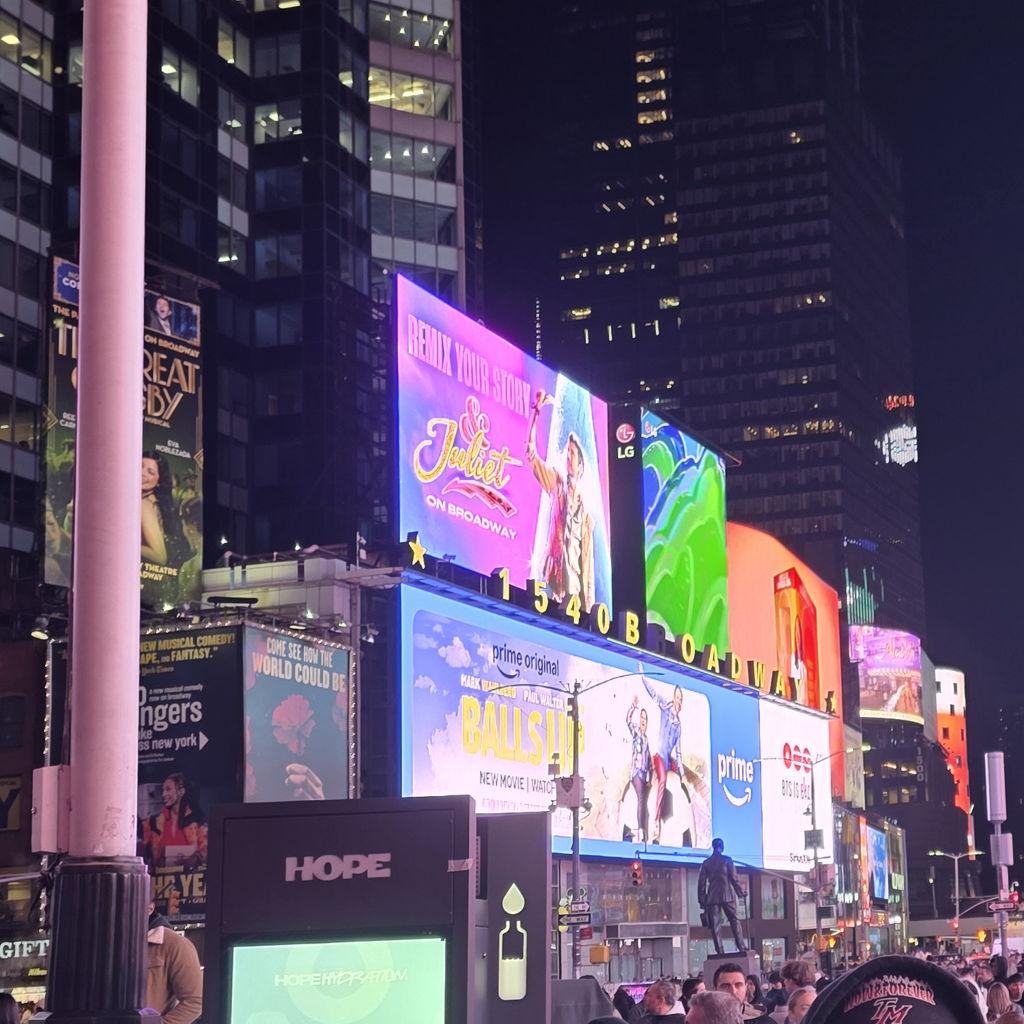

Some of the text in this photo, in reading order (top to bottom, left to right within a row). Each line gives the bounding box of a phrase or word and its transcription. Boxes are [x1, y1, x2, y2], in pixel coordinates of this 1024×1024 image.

[158, 339, 200, 358] BROADWAY
[143, 348, 200, 394] REAT
[407, 314, 531, 419] REMIX YOUR STORY
[413, 417, 523, 490] Juliet
[617, 446, 635, 460] LG
[426, 495, 517, 541] ON BROADWAY
[145, 563, 178, 576] THEATRE
[499, 567, 610, 636] 1540
[158, 636, 195, 650] MUSICAL
[196, 633, 235, 647] COMEDY!
[266, 637, 333, 668] COME SEE HOW THE
[252, 652, 346, 693] WORLD COULD BE
[492, 643, 560, 678] prime original
[460, 674, 480, 689] MARK
[140, 701, 203, 732] ngers
[461, 695, 542, 766] BALLS
[152, 738, 173, 750] new
[175, 733, 197, 751] york
[480, 771, 498, 787] NEW
[500, 773, 525, 790] MOVIE
[717, 748, 754, 784] prime
[285, 853, 391, 881] HOPE
[0, 939, 50, 959] GIFT
